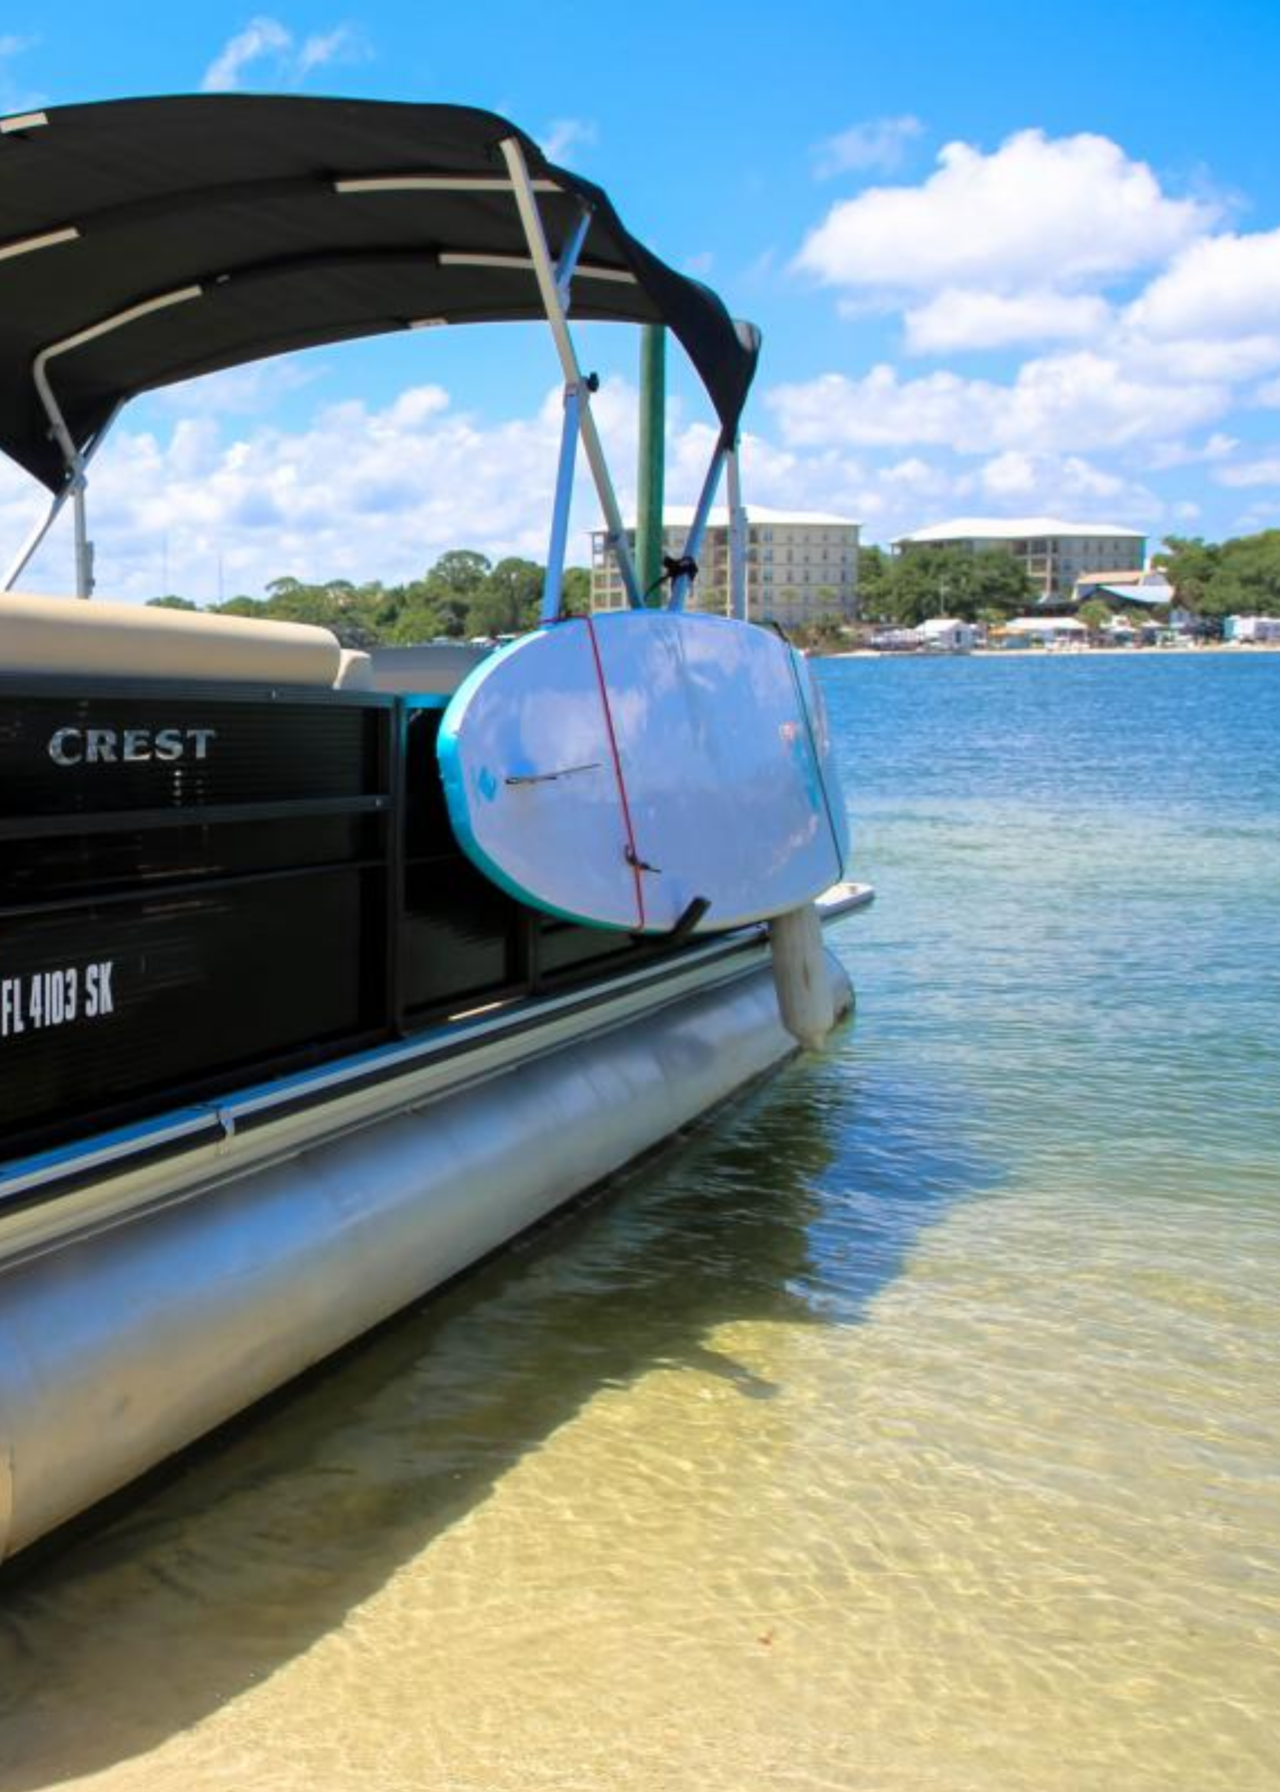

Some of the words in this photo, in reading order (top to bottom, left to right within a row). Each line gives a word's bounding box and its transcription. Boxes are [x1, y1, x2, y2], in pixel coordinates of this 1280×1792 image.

[48, 727, 217, 767] CREST
[1, 977, 25, 1036] FL
[29, 967, 78, 1028] 4103
[85, 961, 114, 1017] SK
